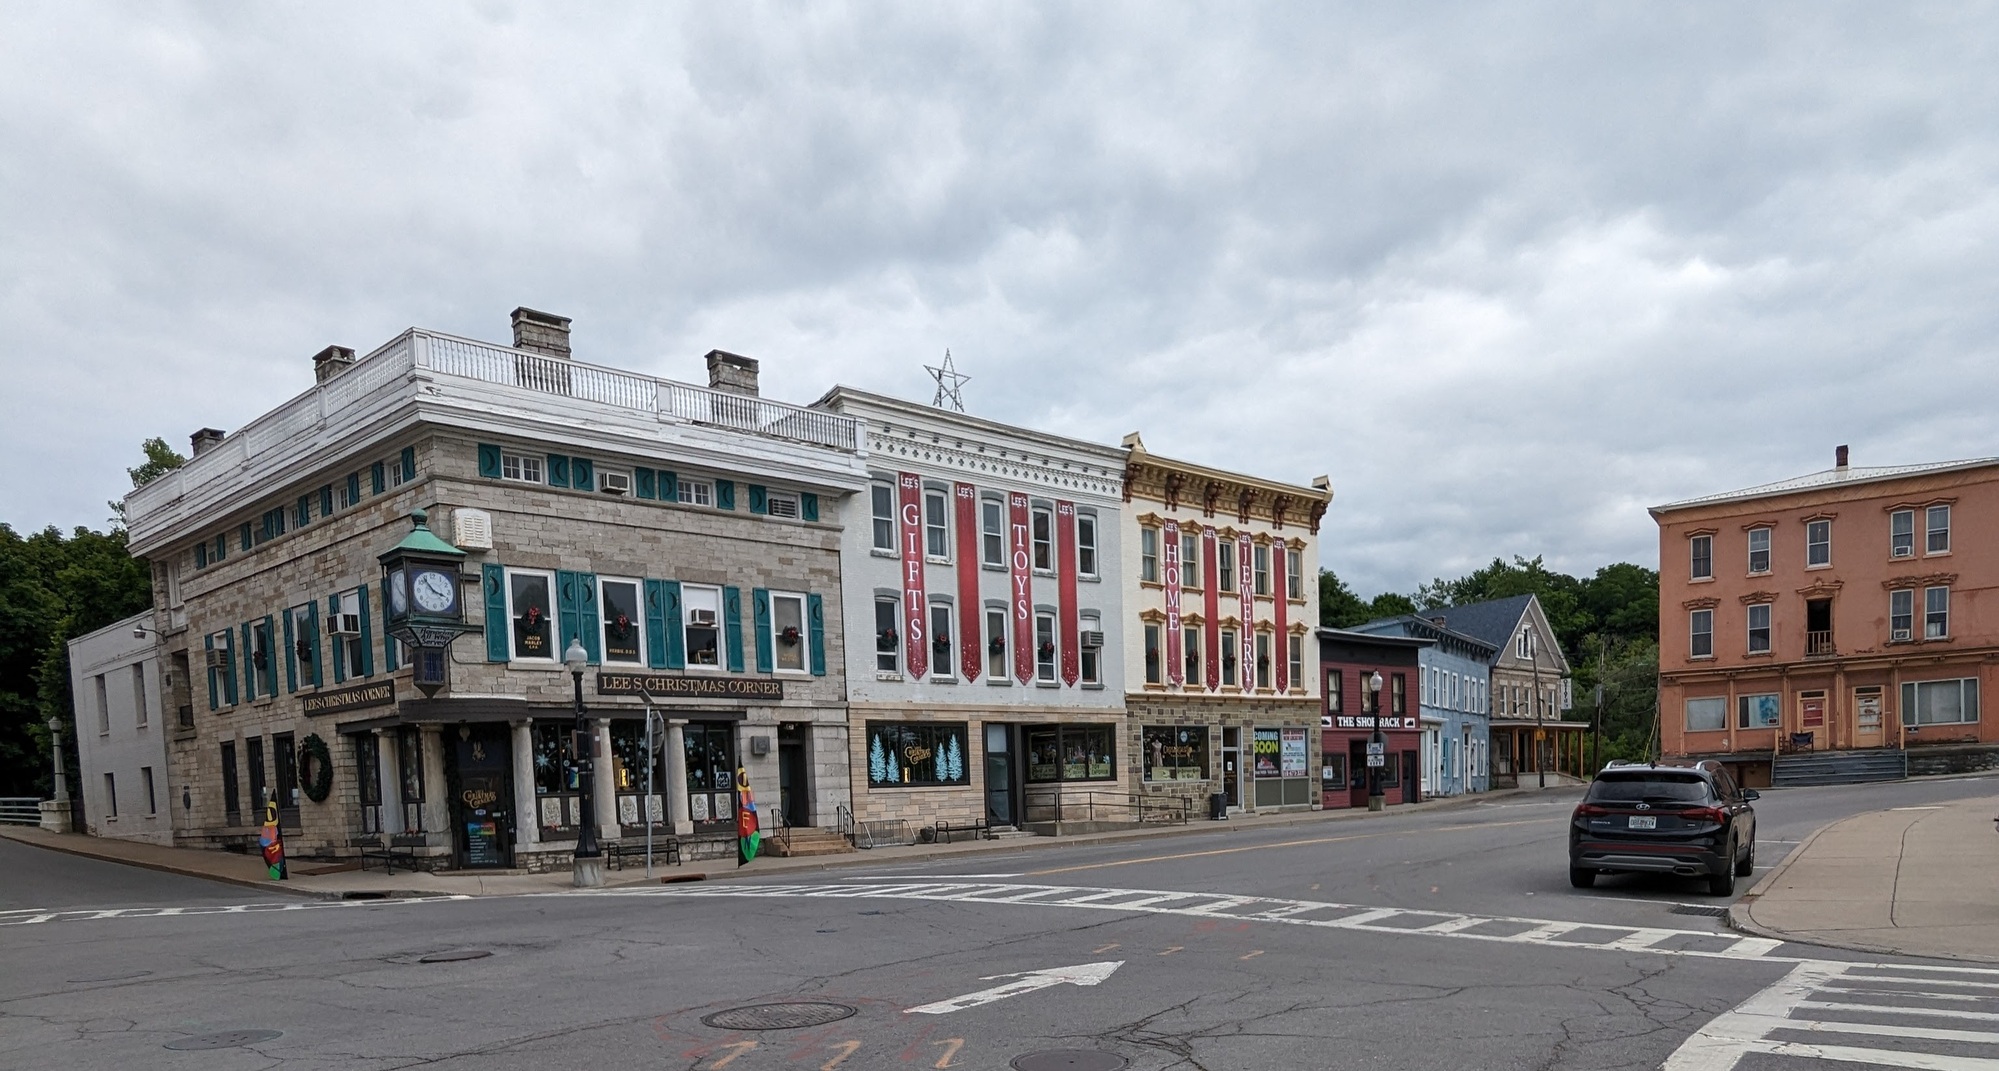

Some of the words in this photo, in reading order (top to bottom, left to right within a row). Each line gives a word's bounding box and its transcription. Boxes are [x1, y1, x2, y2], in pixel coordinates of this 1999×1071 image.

[900, 475, 919, 489] LEE'S
[957, 485, 974, 498] LEE'S
[1011, 494, 1027, 508] LEE'S
[1058, 502, 1073, 515] LEE'S
[1165, 521, 1178, 532] LEE'S
[1204, 528, 1216, 540] LEE'S
[1239, 534, 1251, 545] LEE'S
[1273, 539, 1285, 550] LEE'S
[902, 503, 922, 640] GIFTS
[1012, 523, 1028, 620] TOYS
[1165, 544, 1180, 631] HOME
[1241, 546, 1254, 681] JEWELRY
[645, 677, 726, 693] CHRISTMAS
[728, 681, 781, 694] CORNER
[321, 690, 360, 708] CHRISTMAS
[361, 685, 391, 702] CORNER
[1337, 716, 1355, 727] THE
[1379, 717, 1400, 728] RACK
[1254, 731, 1278, 741] COMING
[1254, 740, 1278, 753] SOON
